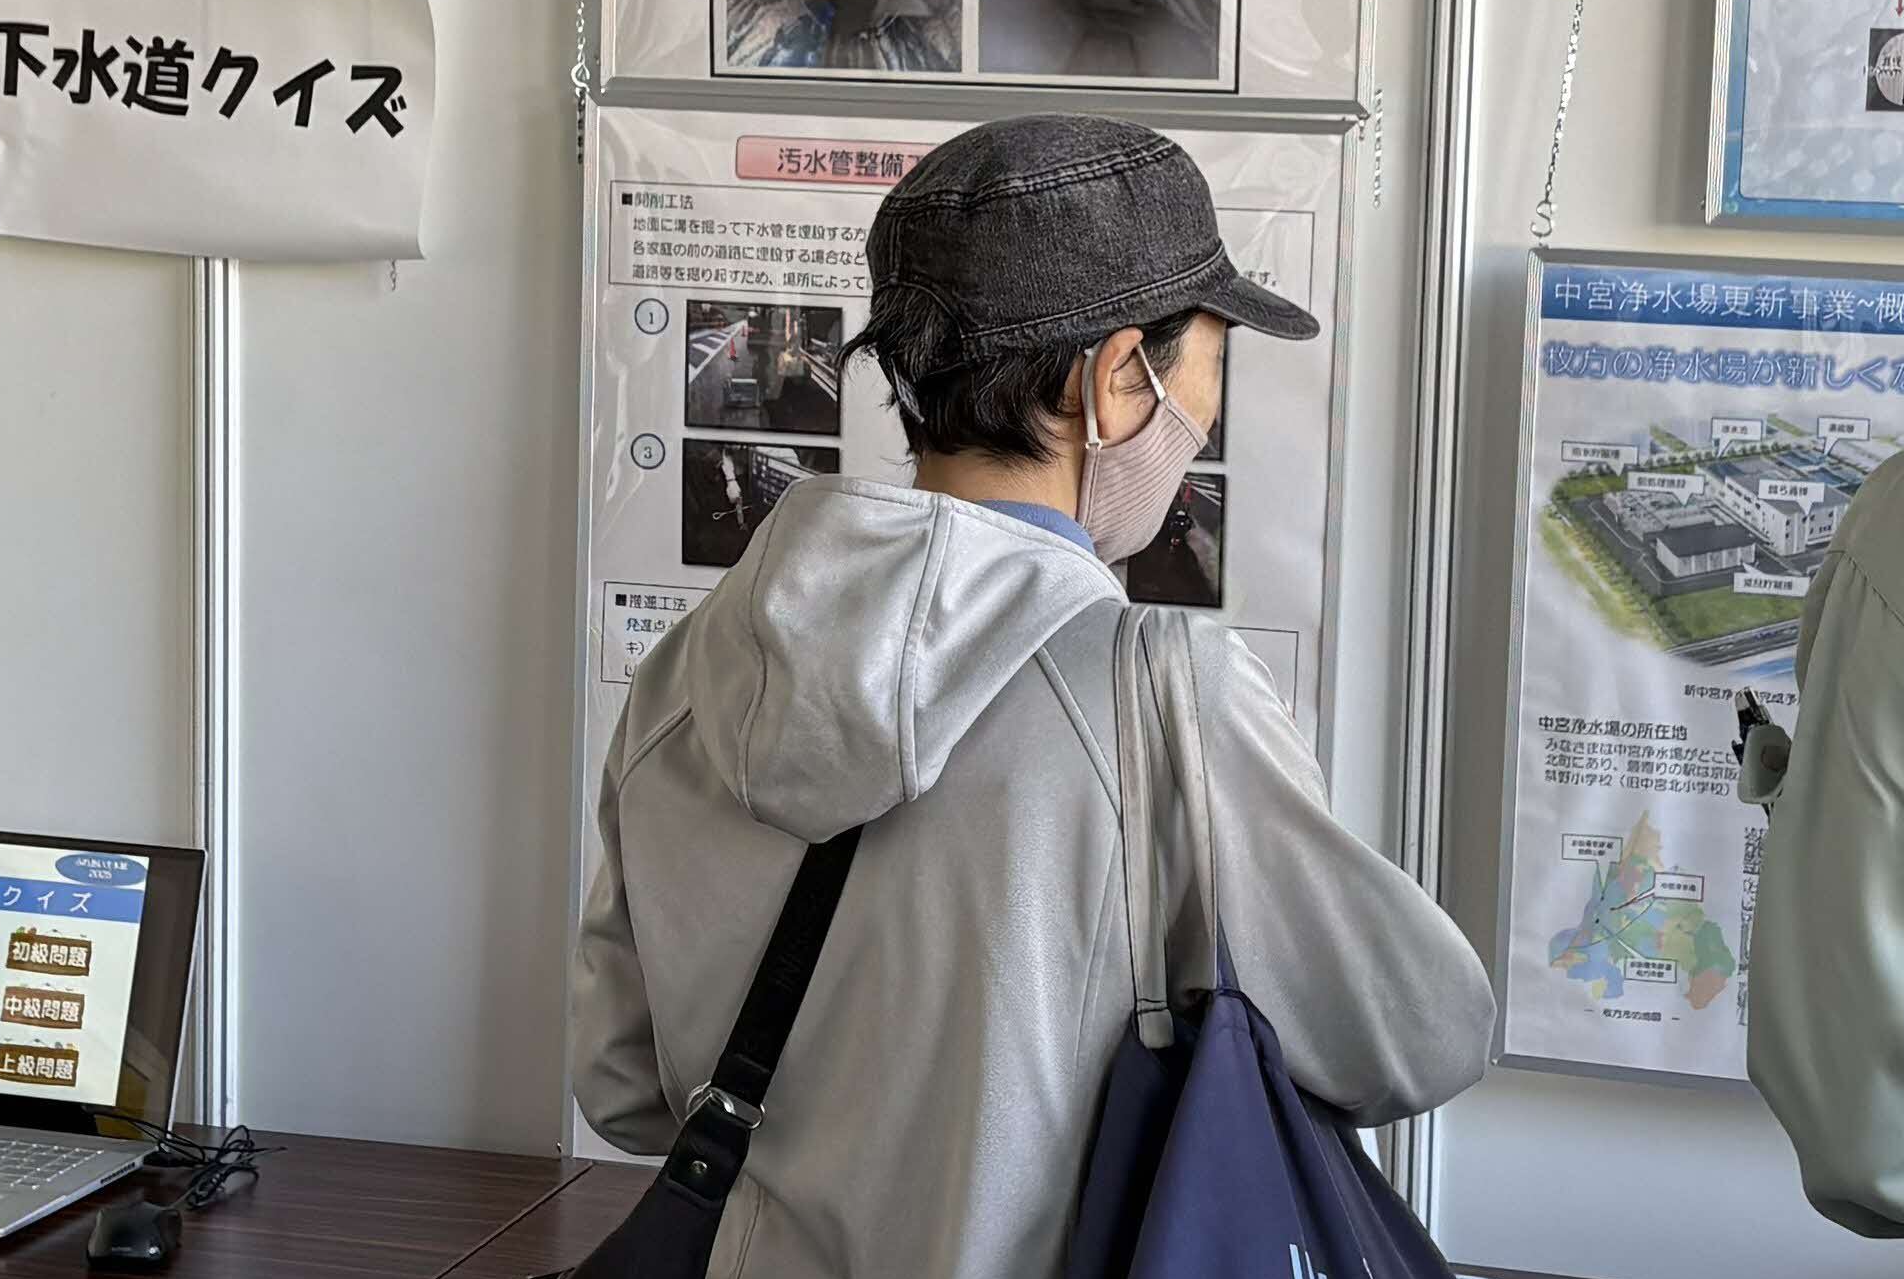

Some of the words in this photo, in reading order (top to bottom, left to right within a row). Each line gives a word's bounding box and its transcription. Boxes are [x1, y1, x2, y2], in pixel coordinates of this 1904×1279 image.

[632, 264, 871, 291] 道路等を掘り起すため、場所によって
[1538, 715, 1688, 741] 中宮浄水場の所在地
[1545, 737, 1738, 765] みなさまは中宮浄水場がどこに
[12, 941, 87, 969] 初級問題
[4, 995, 80, 1022] 中級問題
